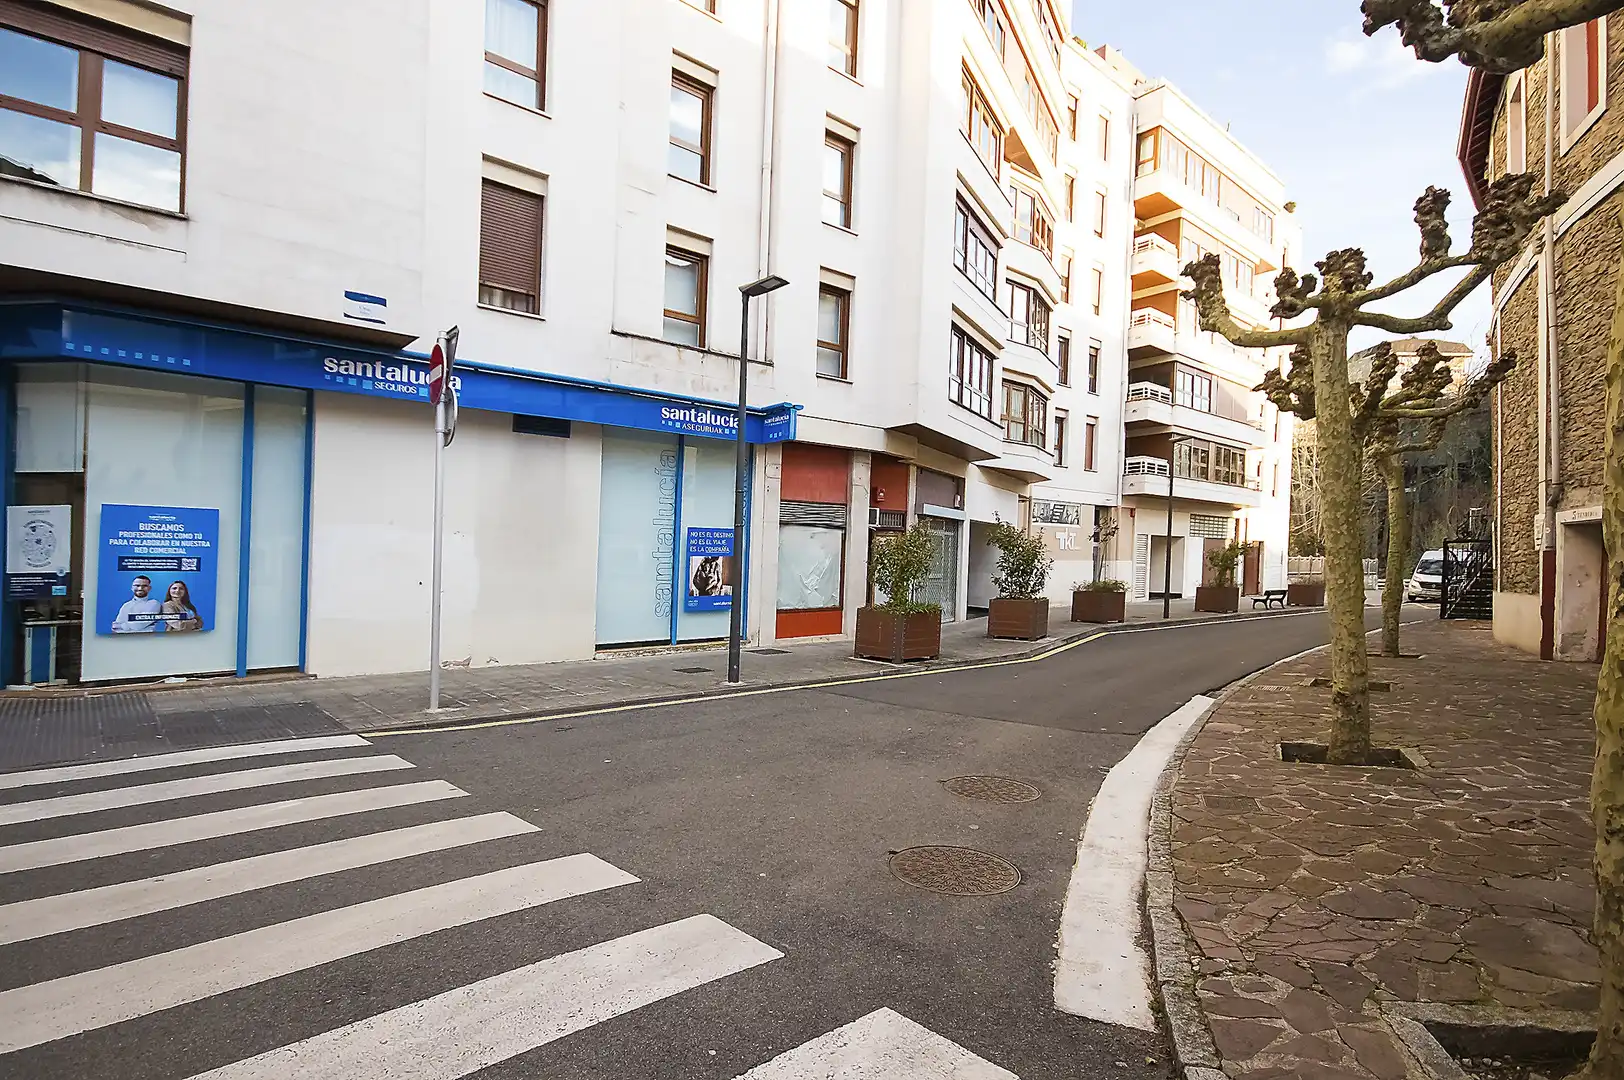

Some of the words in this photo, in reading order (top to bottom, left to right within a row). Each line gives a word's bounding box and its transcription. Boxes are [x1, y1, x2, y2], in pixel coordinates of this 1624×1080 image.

[323, 357, 462, 391] santalua
[374, 381, 417, 394] SEGUROS
[682, 423, 724, 434] ASEGURUAK
[139, 522, 185, 532] BUSCAMOS
[119, 531, 173, 540] PROFESIONALES
[652, 450, 677, 618] santalucía
[149, 547, 187, 555] COMERCIAL
